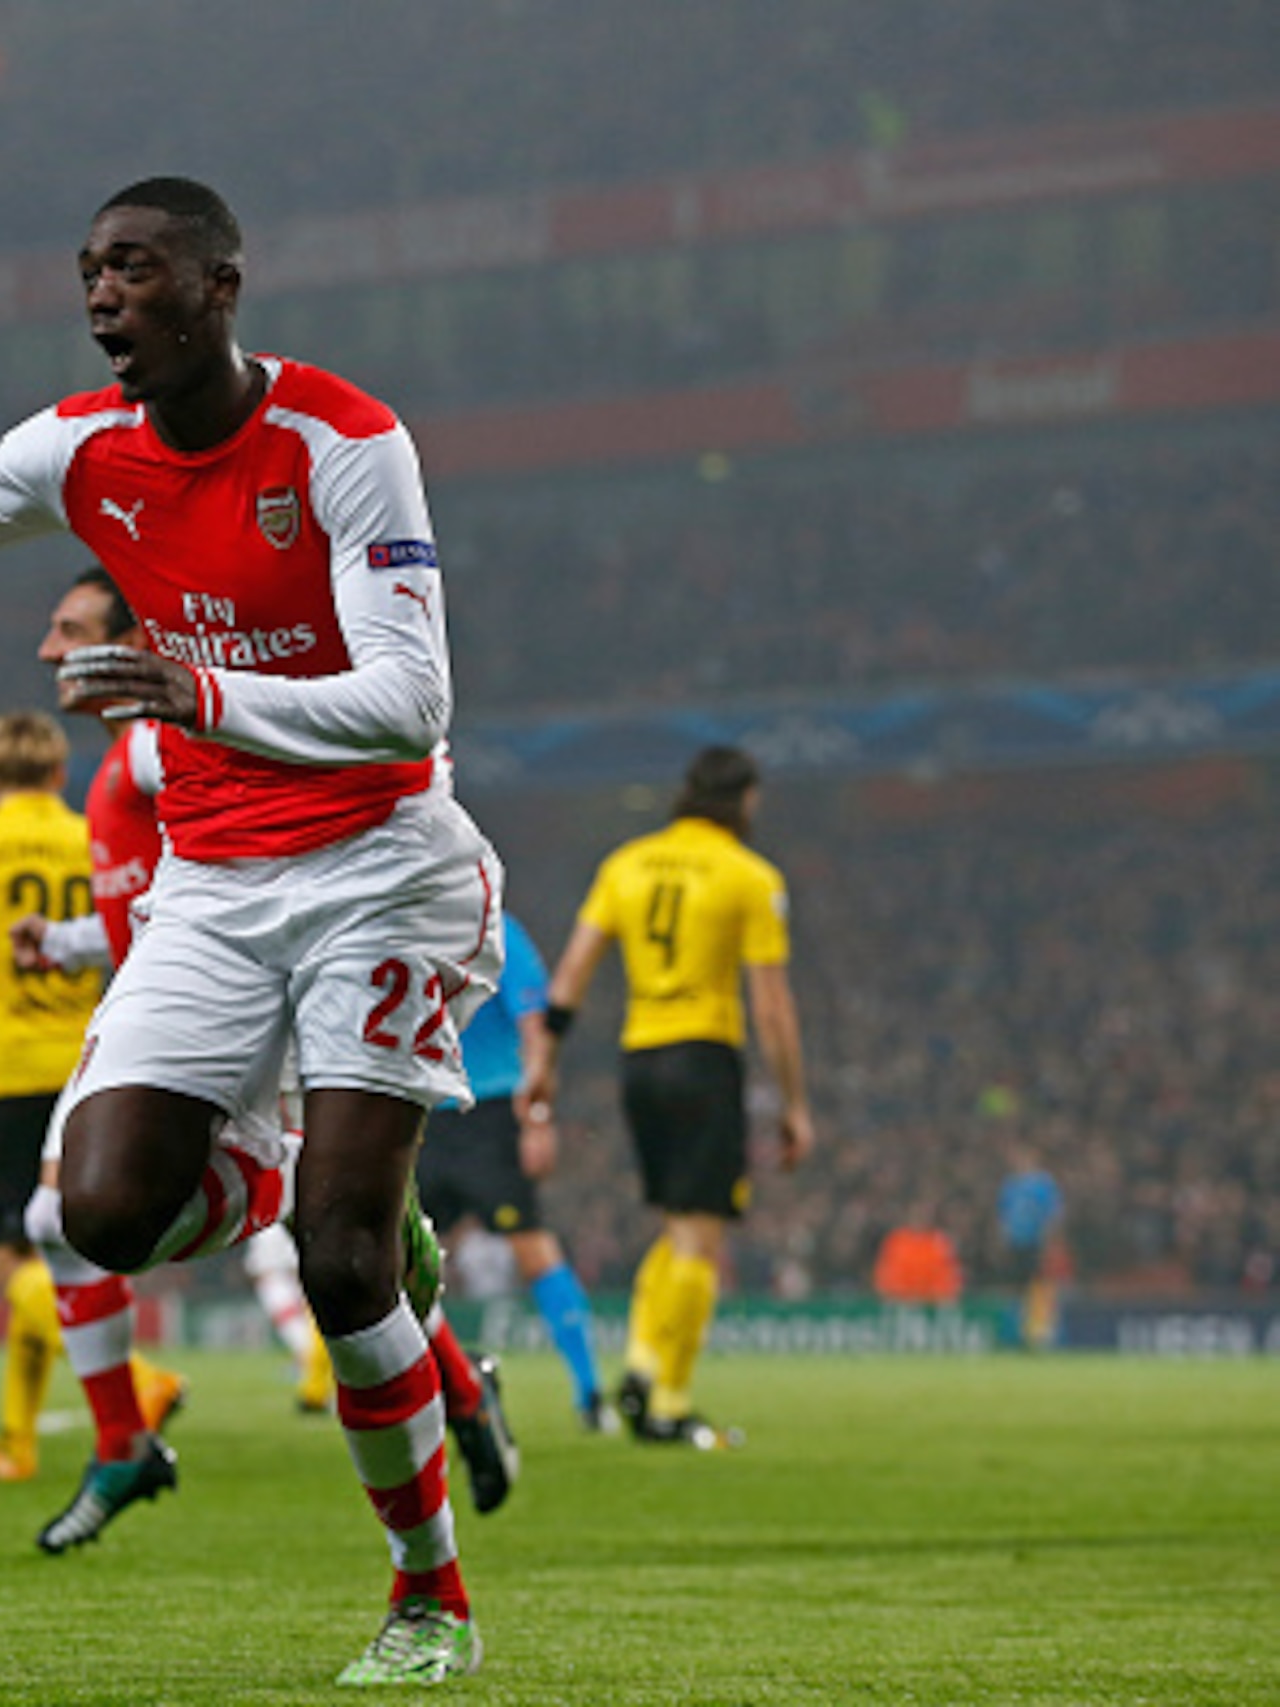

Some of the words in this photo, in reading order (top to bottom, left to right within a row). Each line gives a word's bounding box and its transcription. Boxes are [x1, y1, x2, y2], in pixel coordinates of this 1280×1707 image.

[144, 618, 317, 668] Emirates
[182, 592, 236, 628] Fly
[645, 882, 686, 970] 4
[363, 957, 445, 1063] 22
